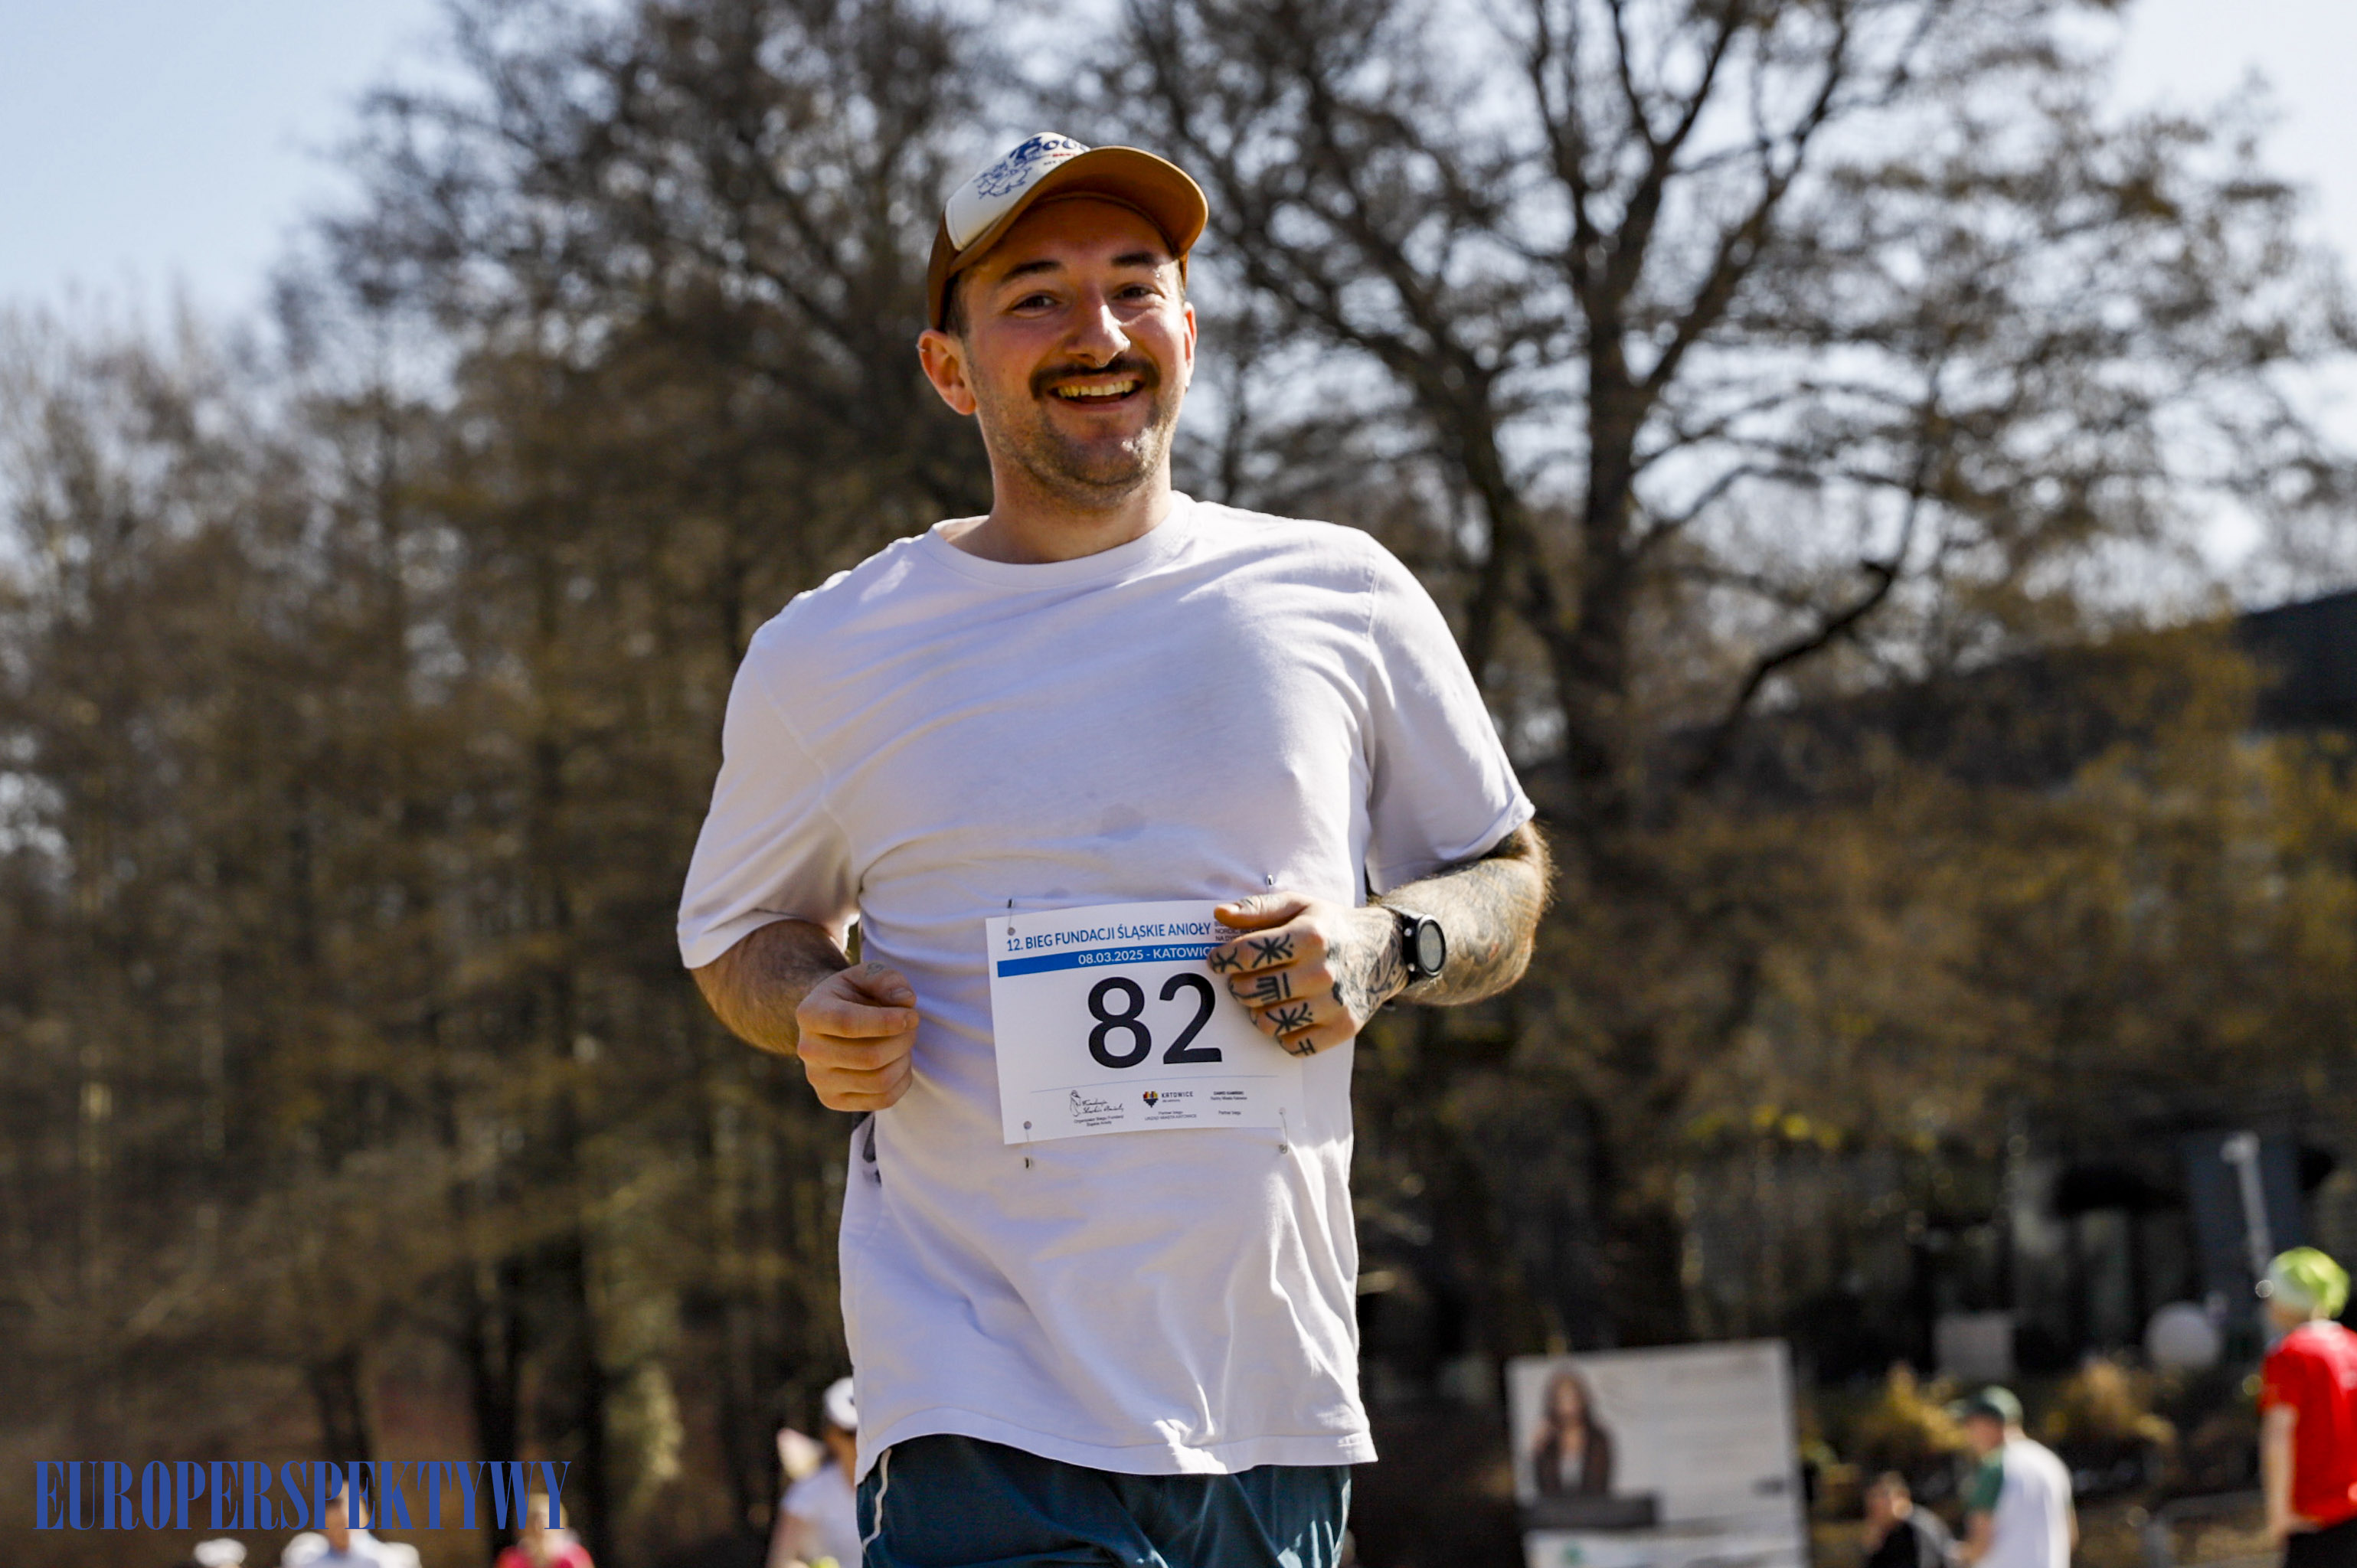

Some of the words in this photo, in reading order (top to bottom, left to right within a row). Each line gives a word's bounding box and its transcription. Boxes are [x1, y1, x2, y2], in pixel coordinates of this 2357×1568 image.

[1007, 938, 1024, 952] 12.
[1025, 934, 1053, 949] BIEG
[1054, 927, 1115, 946] FUNDACJI
[1117, 923, 1165, 941] ŚLĄSKIE
[1168, 922, 1211, 936] ANIOŁY
[1077, 949, 1144, 965] 08.03.2025
[1153, 946, 1214, 959] KATOWIC
[1087, 972, 1223, 1069] 82
